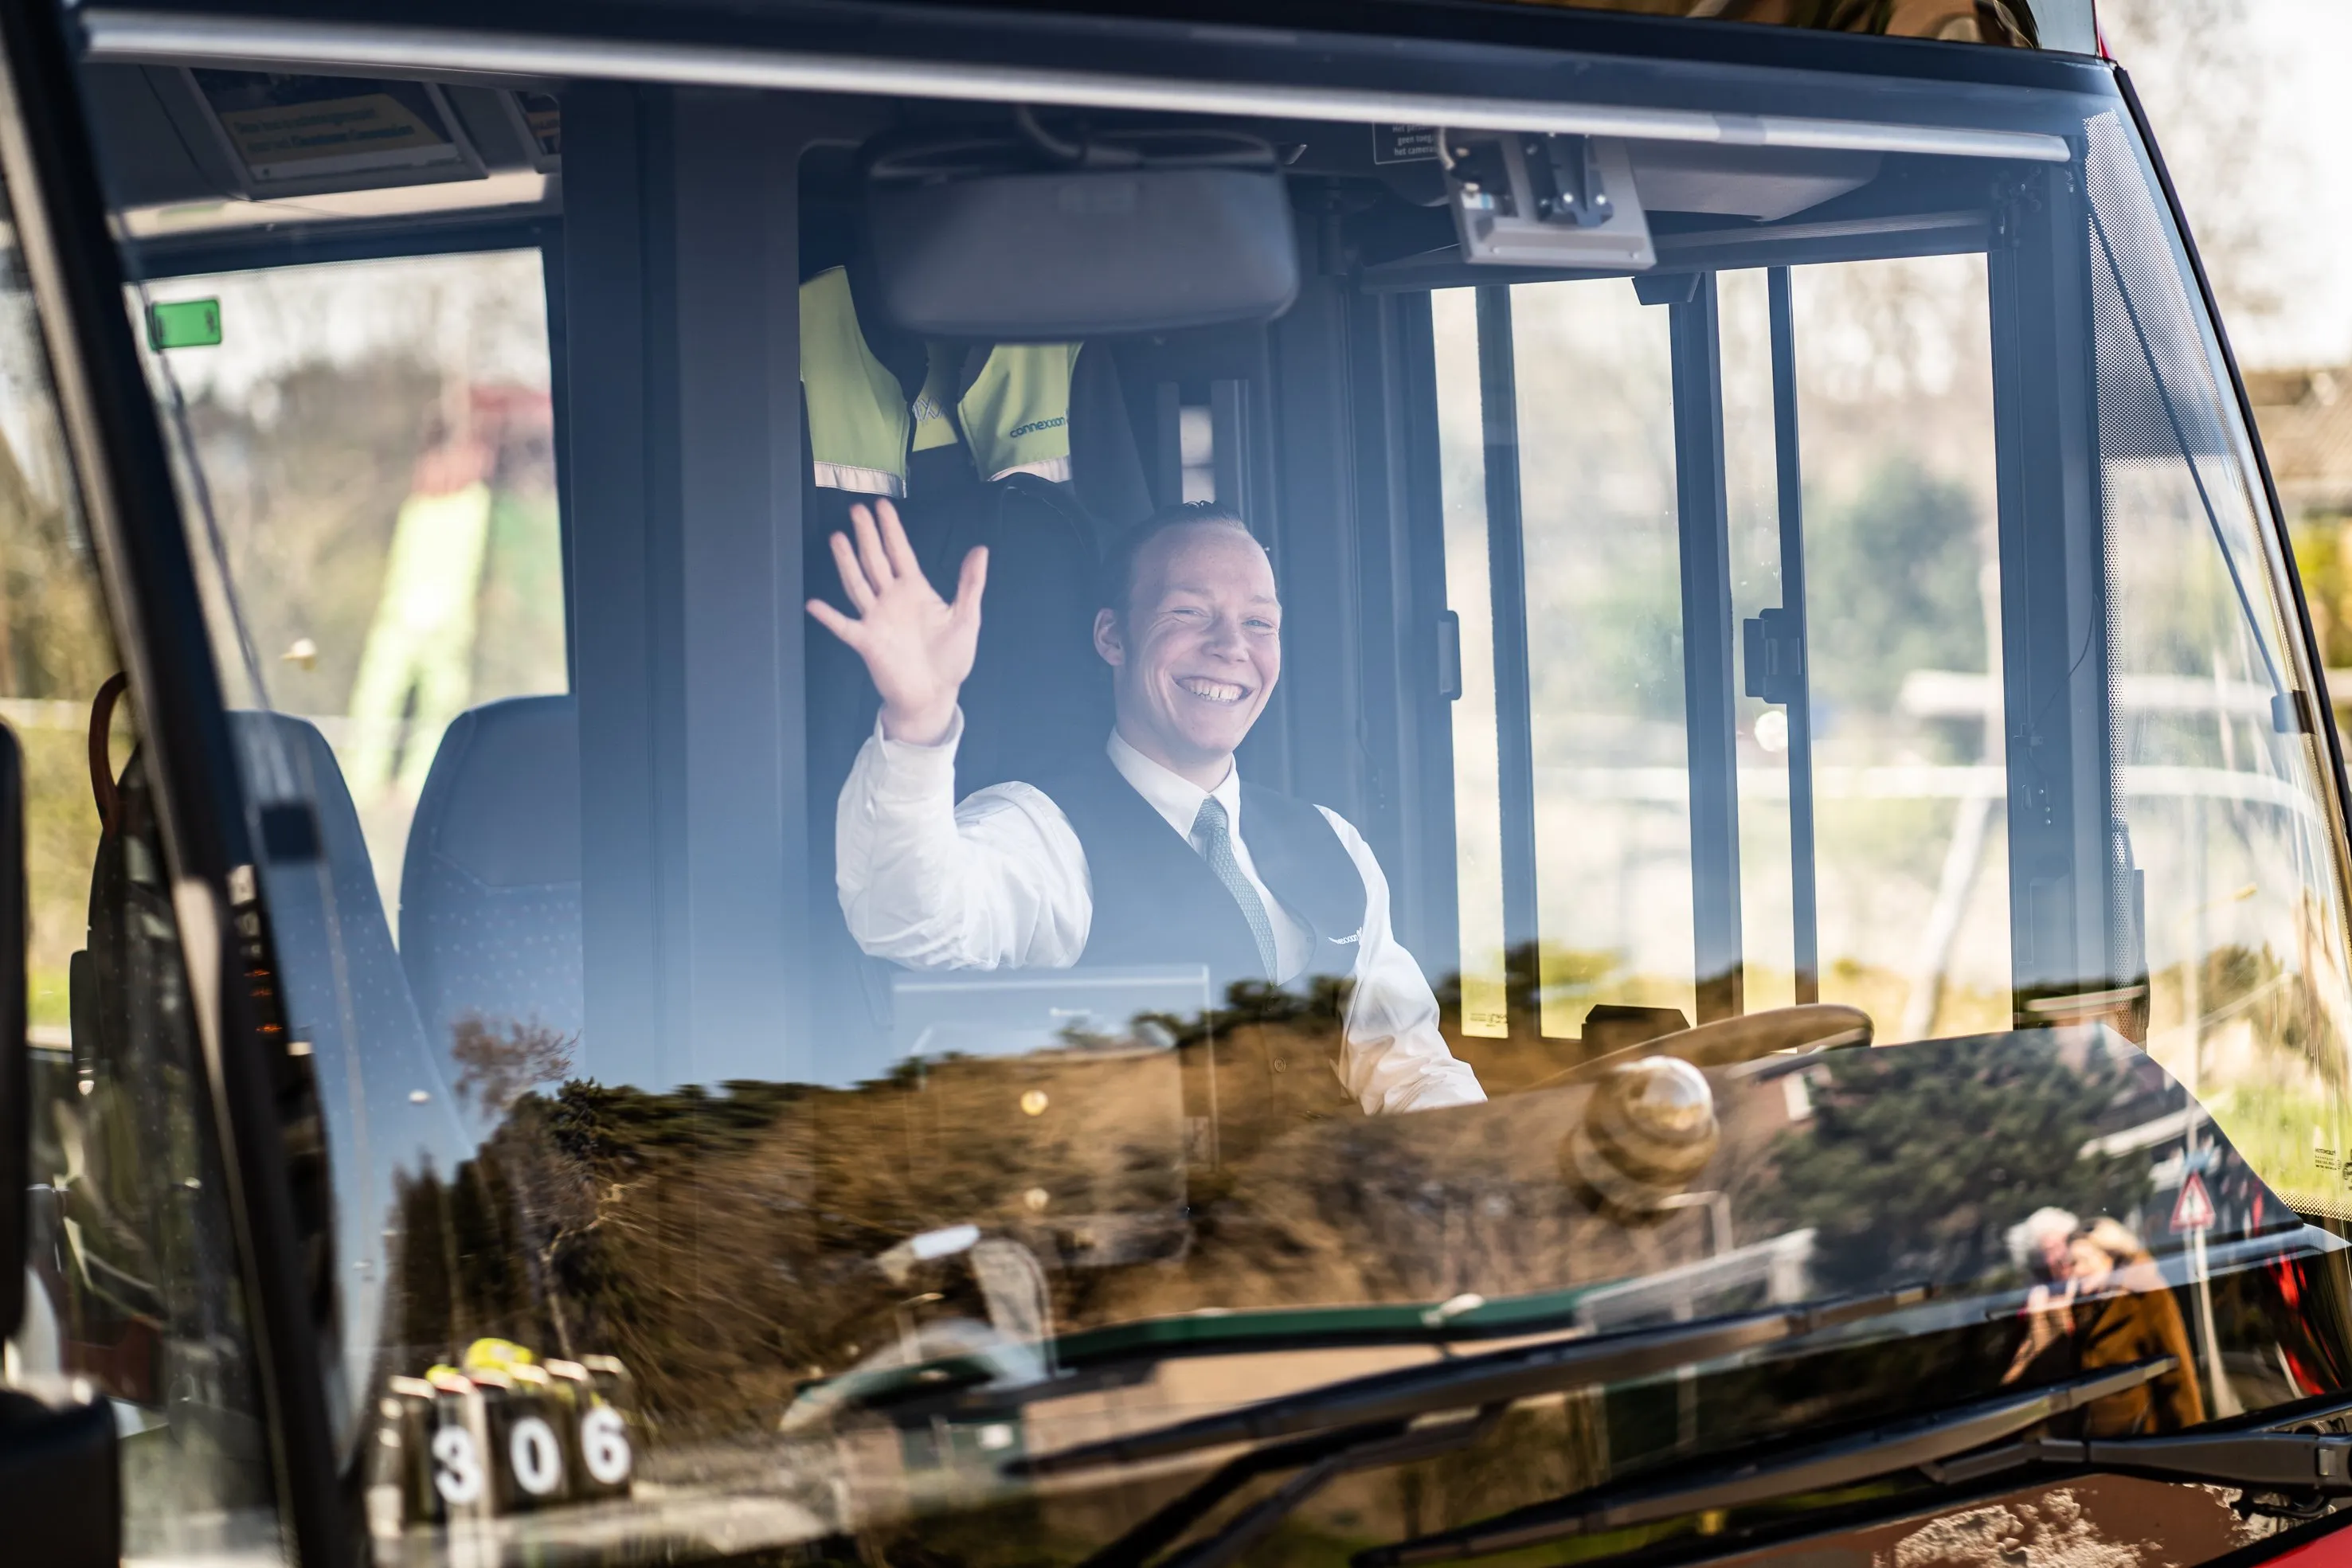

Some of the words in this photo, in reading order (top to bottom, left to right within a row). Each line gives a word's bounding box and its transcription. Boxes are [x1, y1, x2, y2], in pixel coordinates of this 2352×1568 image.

[1397, 136, 1415, 147] geen
[1416, 134, 1434, 144] toeg
[1394, 147, 1407, 156] het
[432, 1406, 632, 1505] 306
